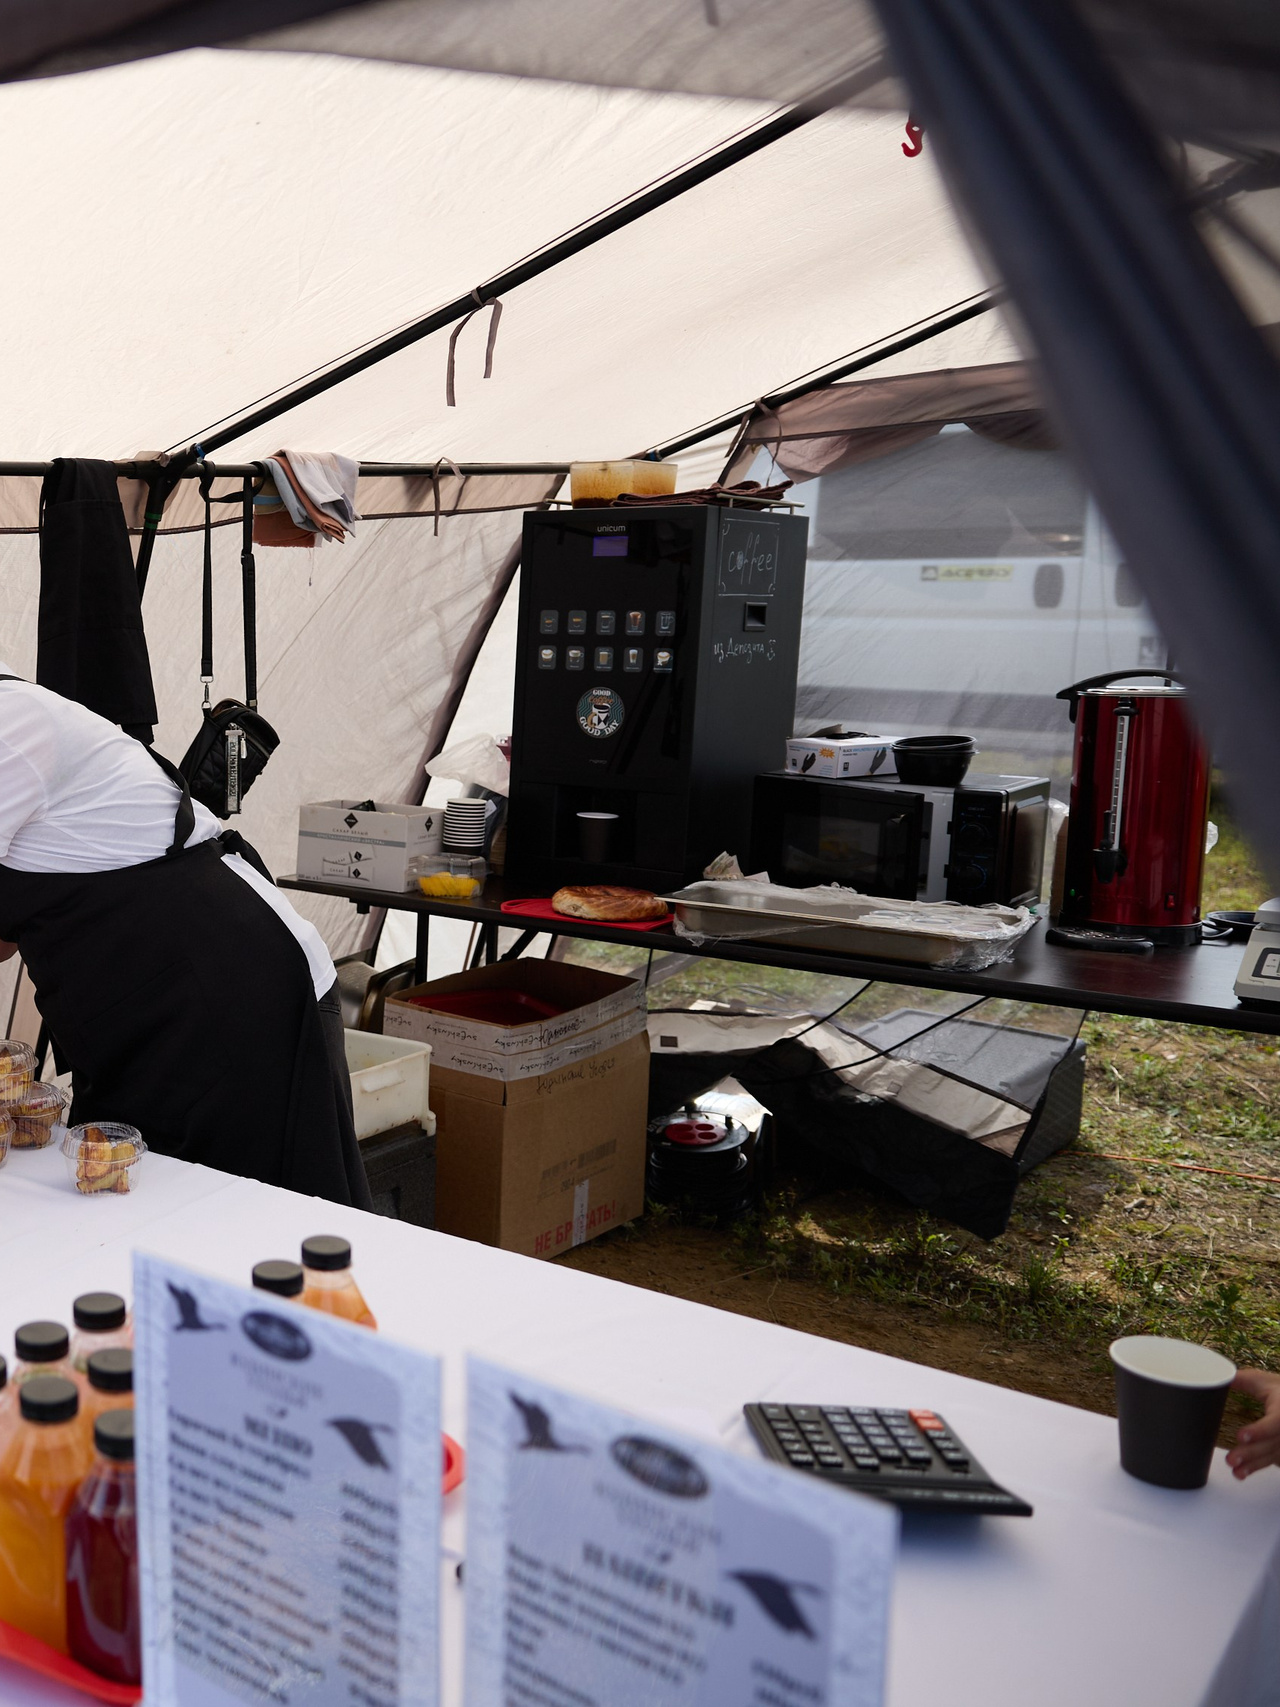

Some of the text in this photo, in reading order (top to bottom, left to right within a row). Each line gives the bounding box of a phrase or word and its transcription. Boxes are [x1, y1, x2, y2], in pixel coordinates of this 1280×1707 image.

[580, 716, 619, 736] GOOD DAY
[534, 1231, 552, 1255] НЕ
[555, 1199, 617, 1245] БРАТЬ!
